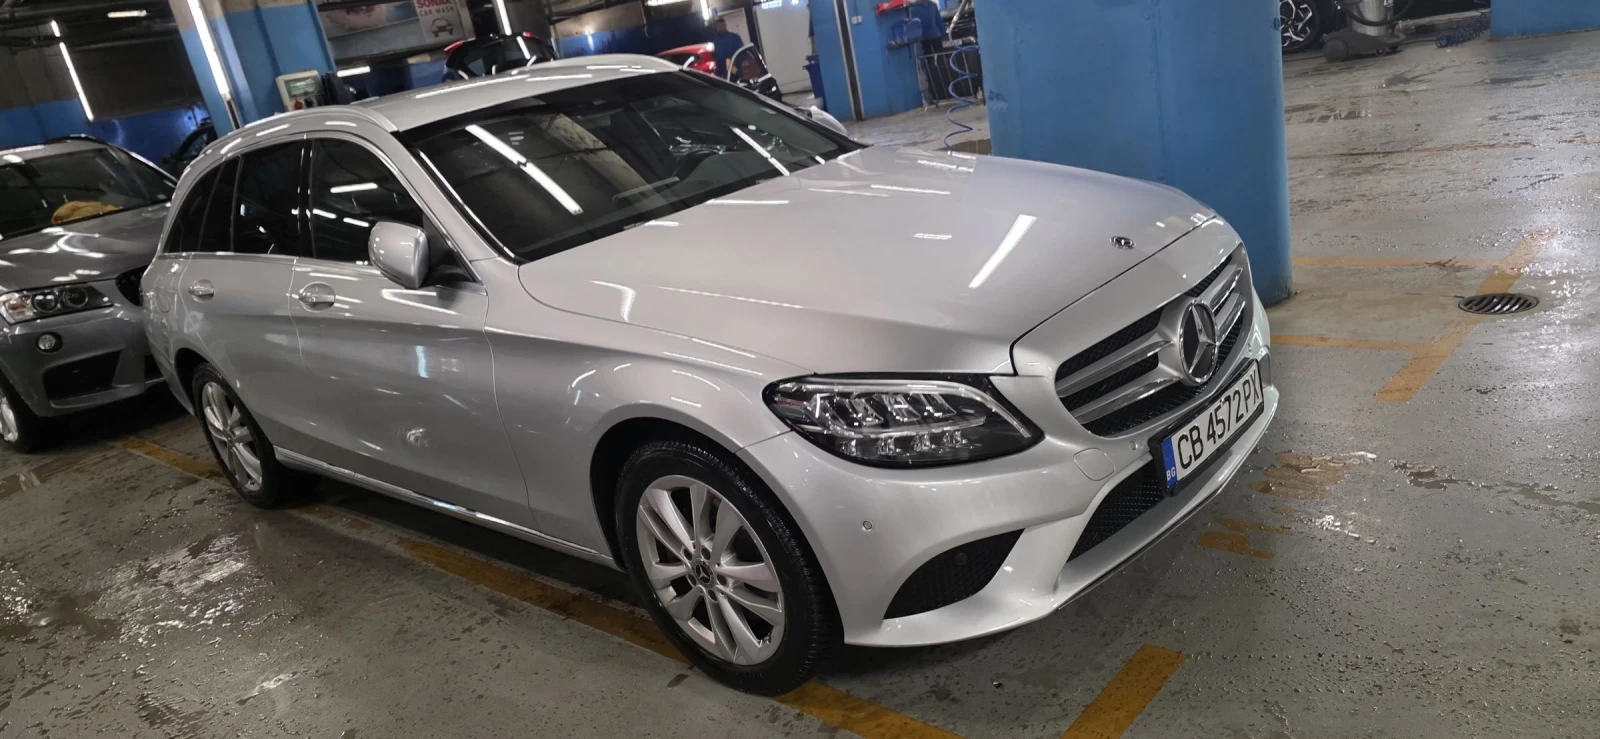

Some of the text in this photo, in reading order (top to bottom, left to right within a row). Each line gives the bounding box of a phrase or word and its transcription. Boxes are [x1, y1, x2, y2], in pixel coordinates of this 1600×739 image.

[435, 5, 455, 13] WASH
[1177, 424, 1204, 470] CB
[1206, 390, 1244, 445] 4572
[1166, 466, 1176, 481] BG
